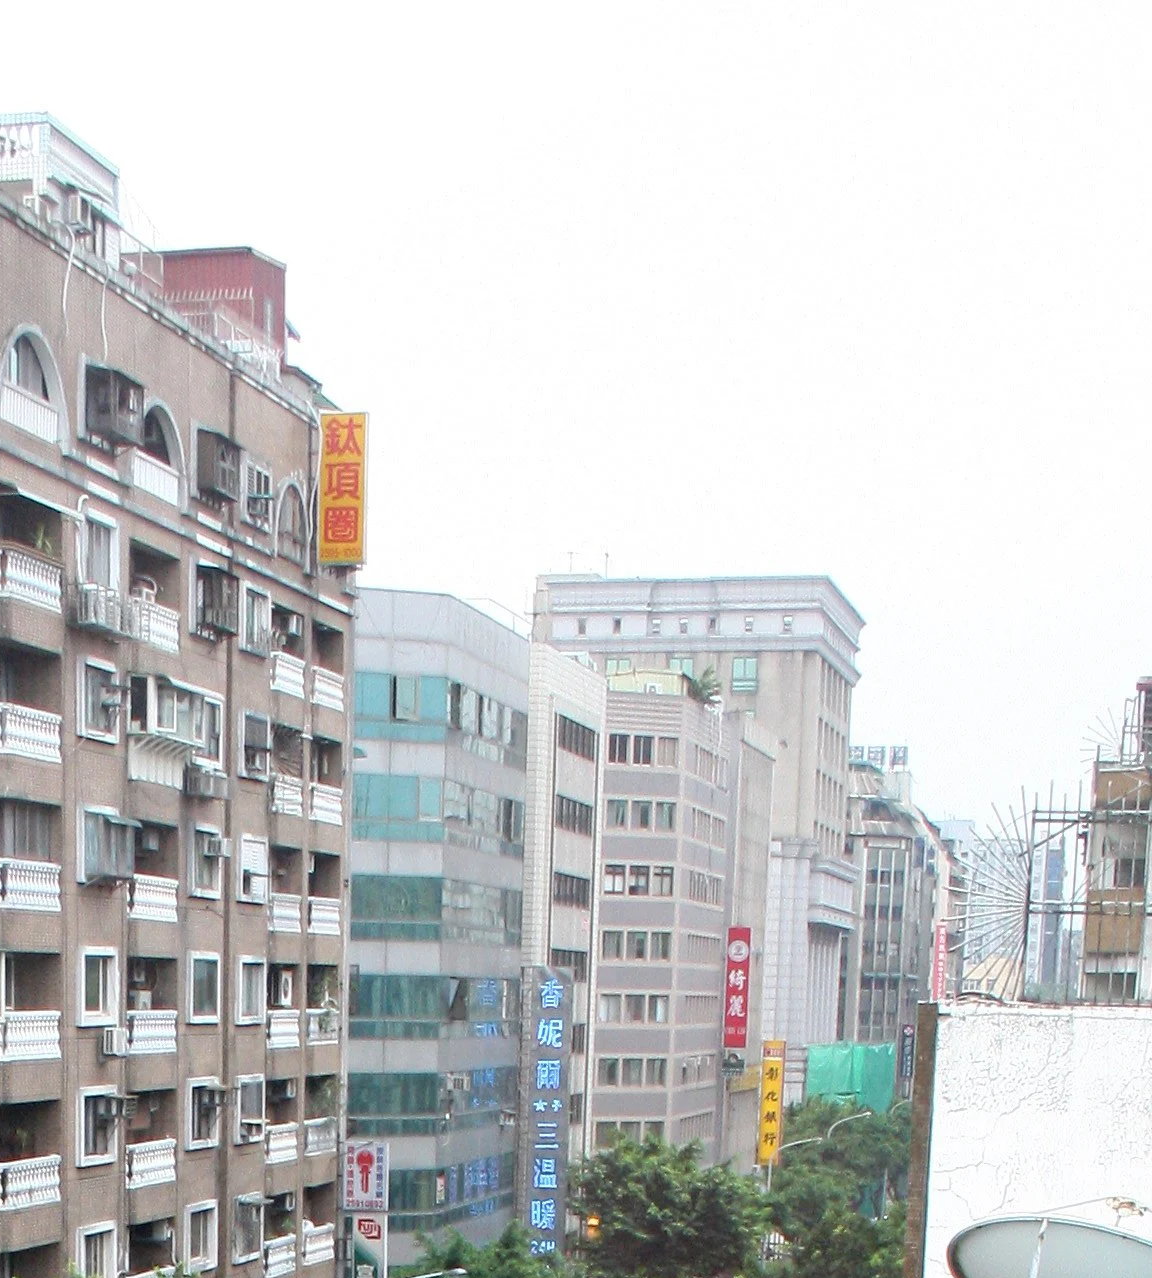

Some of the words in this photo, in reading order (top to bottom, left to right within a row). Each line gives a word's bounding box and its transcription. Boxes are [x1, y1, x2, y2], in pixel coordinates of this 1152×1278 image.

[324, 416, 362, 544] 鈦項圈
[535, 978, 564, 1091] 香妮爾
[763, 1066, 780, 1146] 彰化銀行
[530, 1121, 560, 1230] 三溫暖
